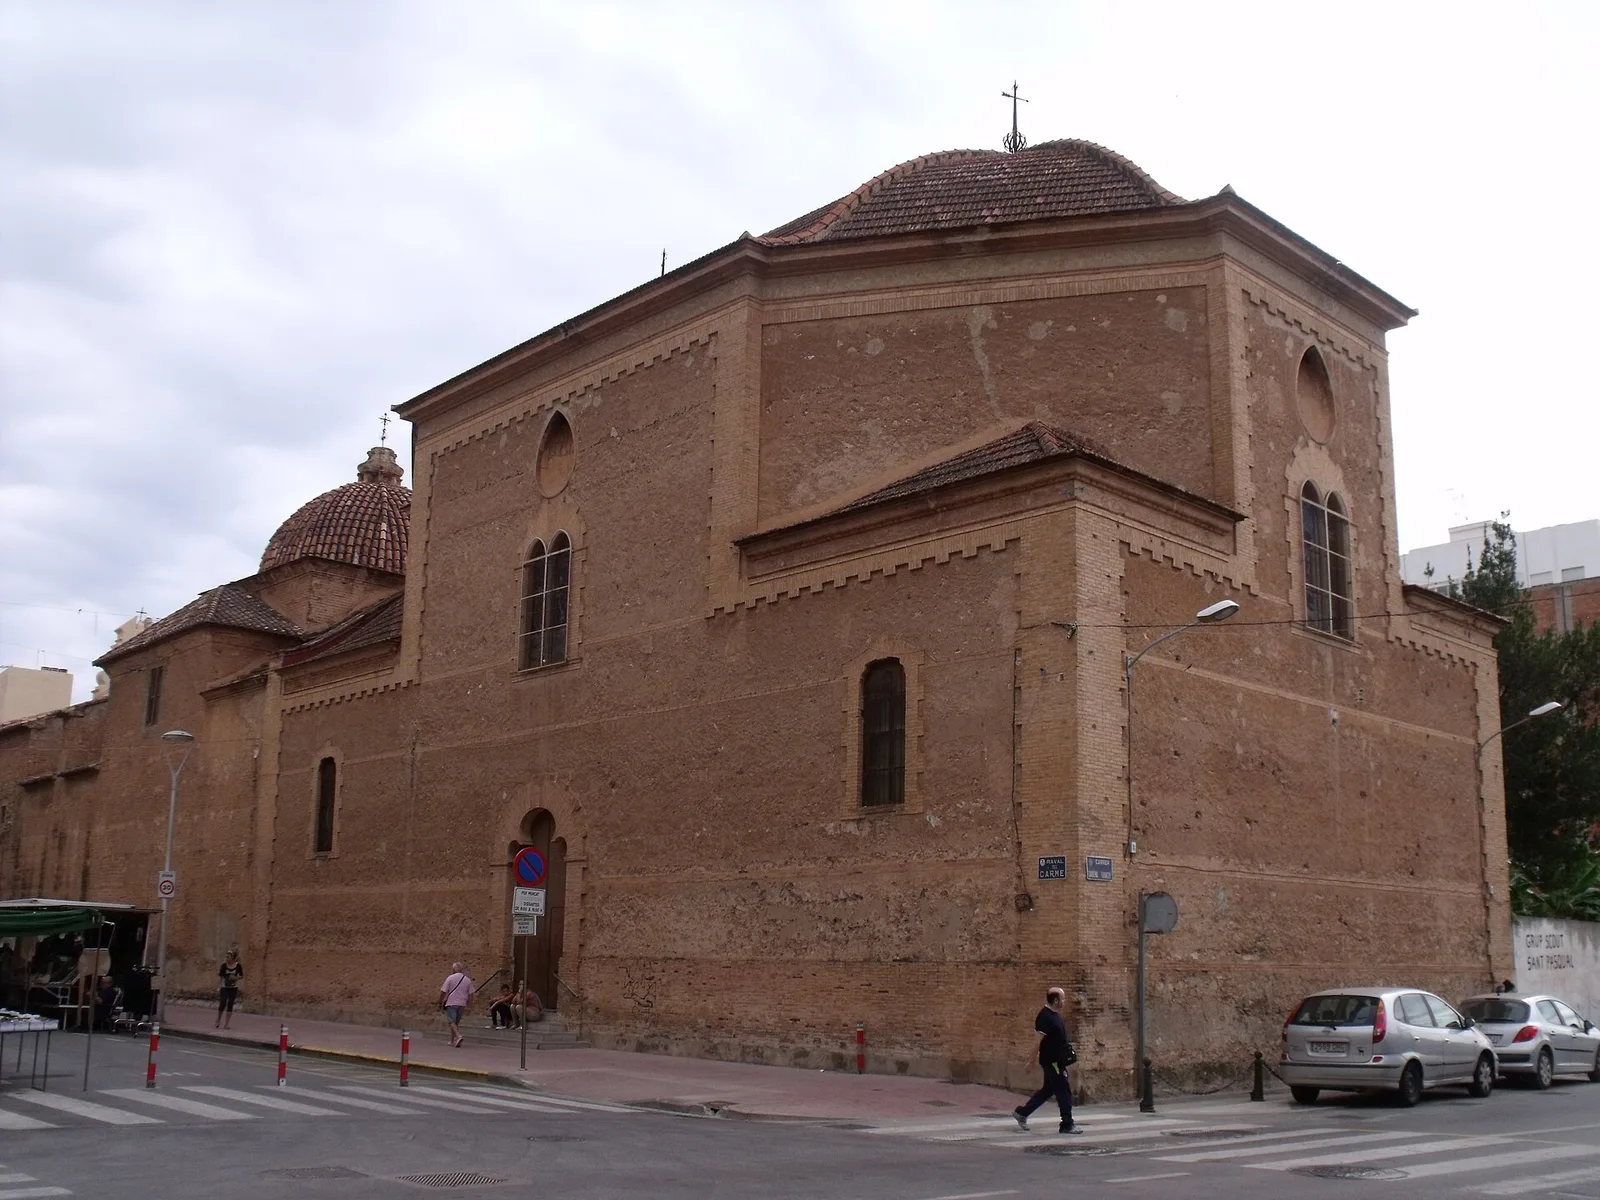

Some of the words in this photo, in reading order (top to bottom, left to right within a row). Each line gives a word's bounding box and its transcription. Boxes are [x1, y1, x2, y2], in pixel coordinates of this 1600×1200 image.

[1040, 869, 1065, 878] CARME
[1526, 934, 1543, 948] GRUP
[1546, 933, 1564, 949] SCOUT
[1527, 955, 1544, 971] SANT
[1546, 953, 1574, 970] PASQUAL
